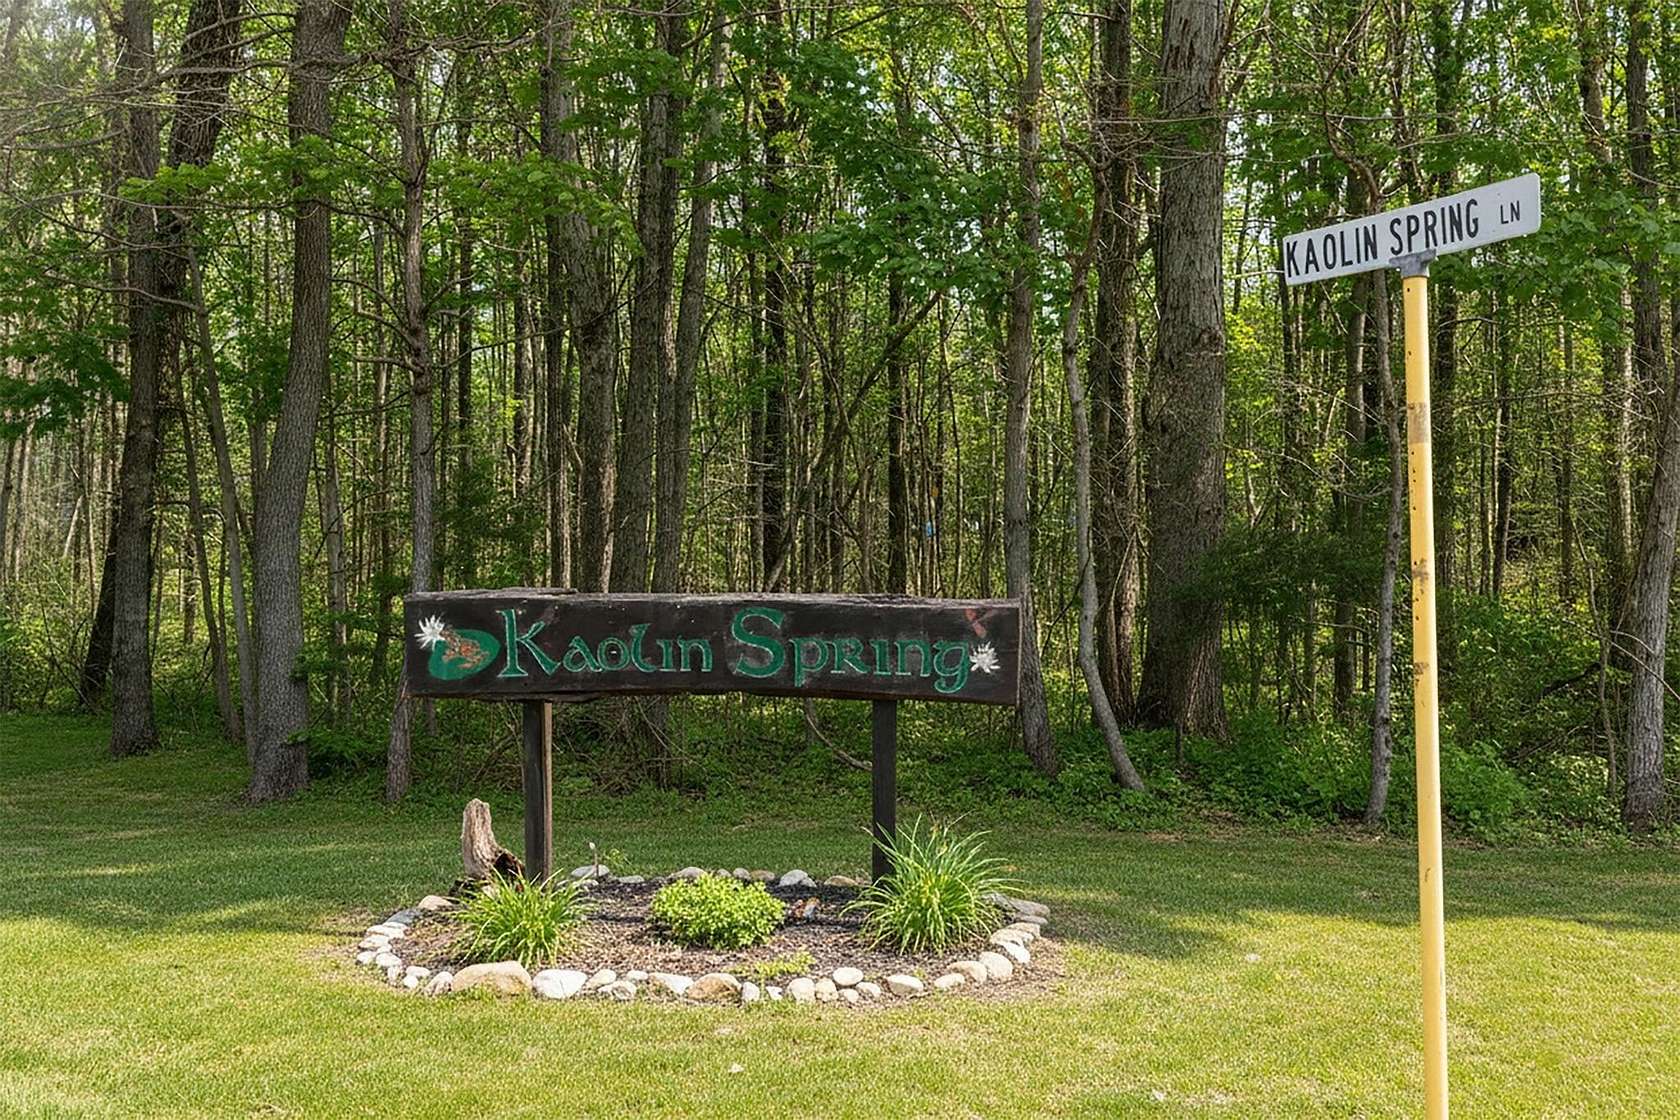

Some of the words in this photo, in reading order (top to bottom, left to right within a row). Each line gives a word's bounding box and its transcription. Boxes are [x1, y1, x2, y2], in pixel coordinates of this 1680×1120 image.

[1286, 223, 1378, 278] KAOLIN
[1389, 199, 1479, 256] SPRING
[1500, 200, 1521, 225] LN
[495, 608, 714, 678] Kaolin
[731, 606, 970, 694] Spring
